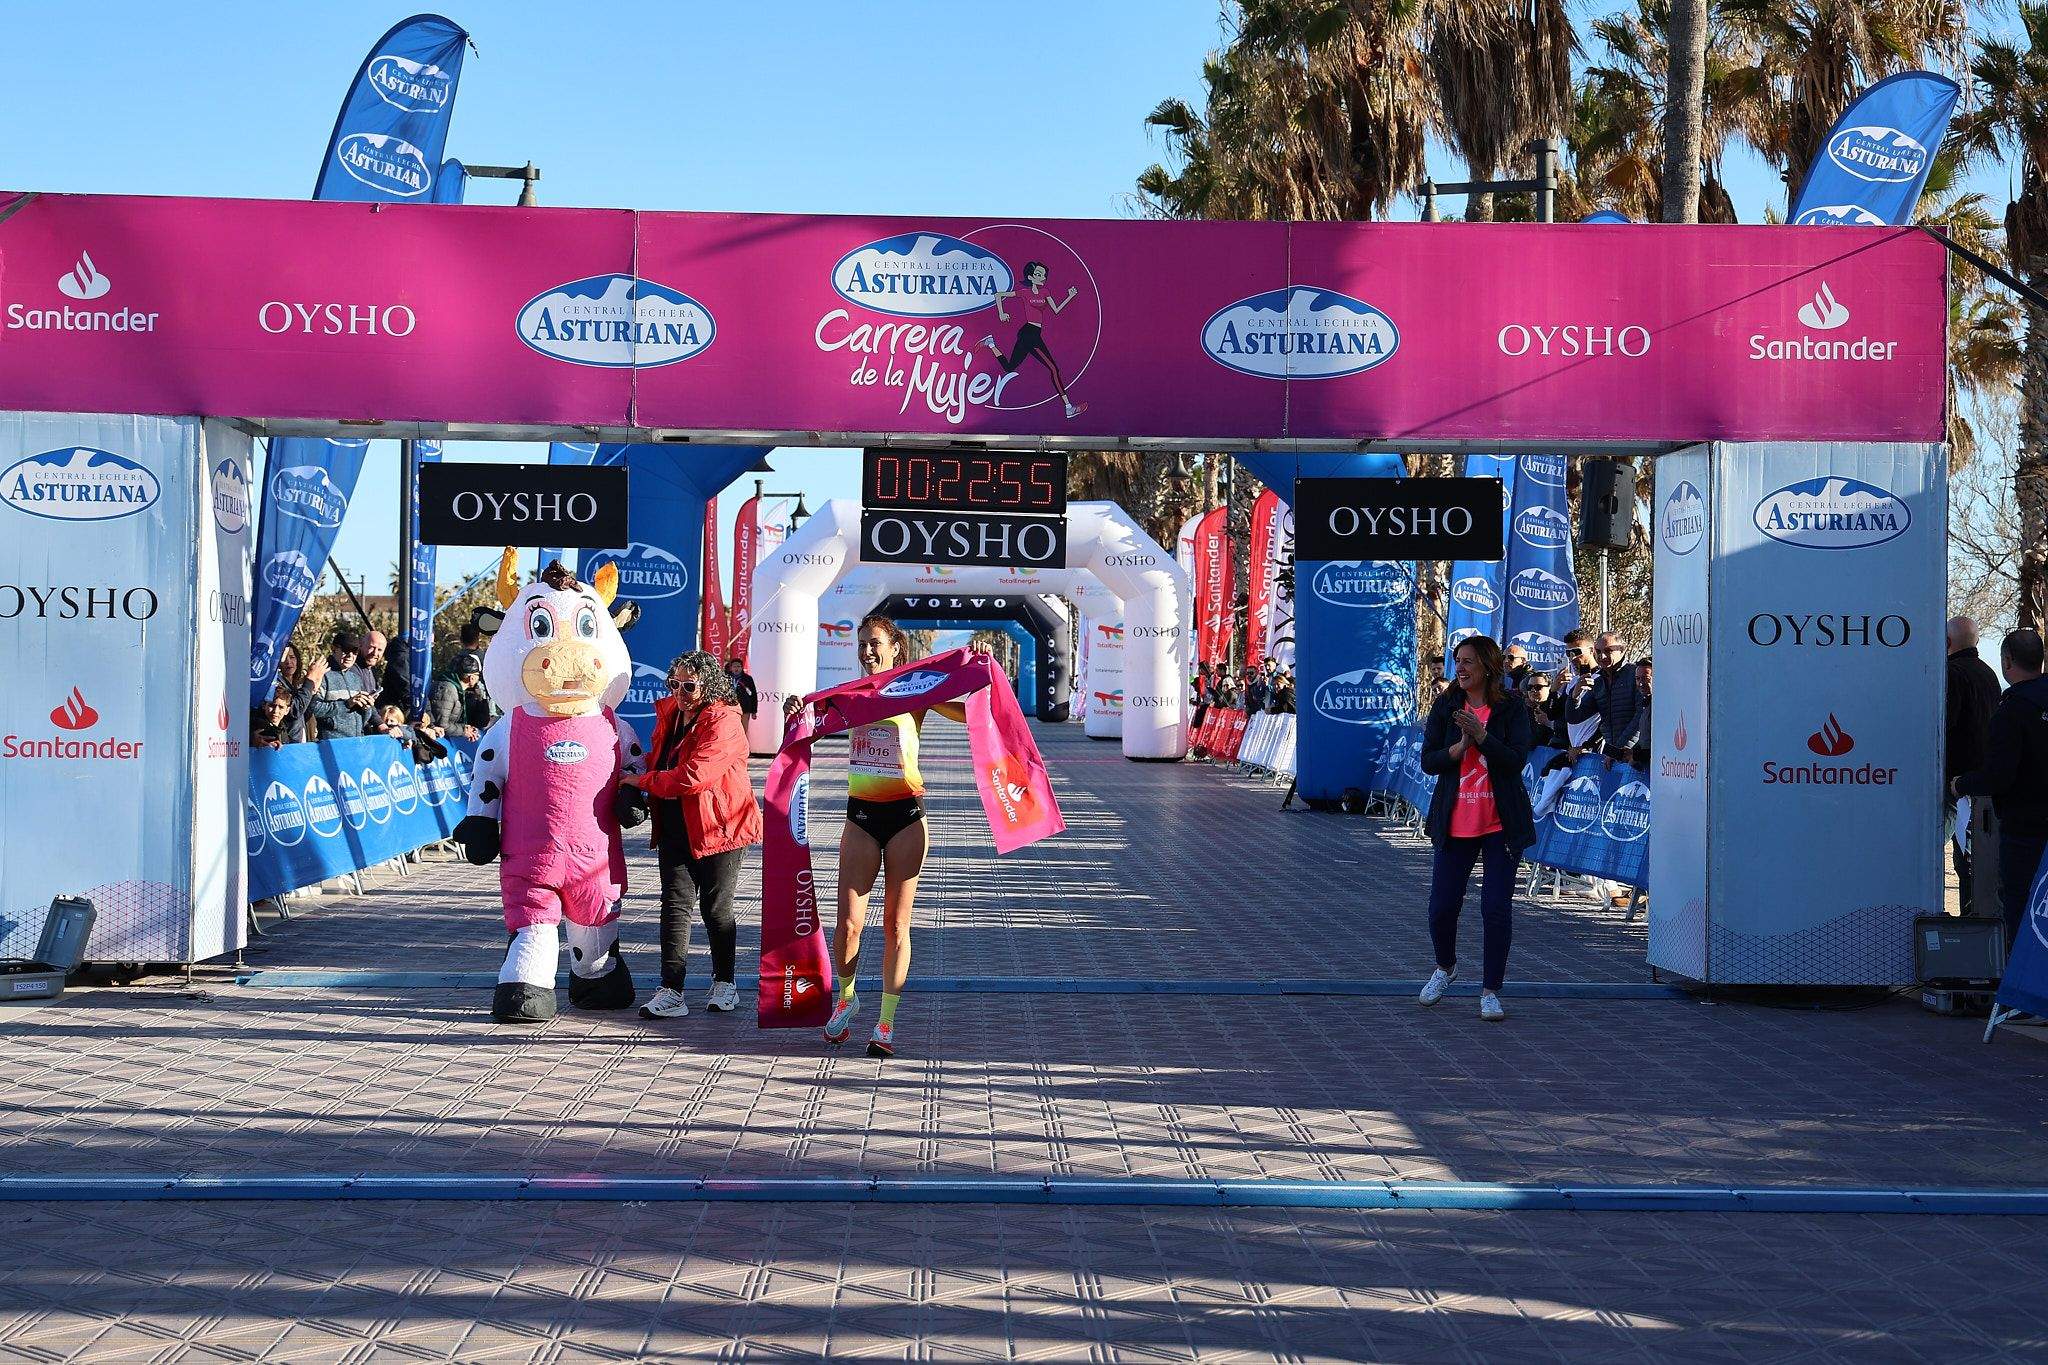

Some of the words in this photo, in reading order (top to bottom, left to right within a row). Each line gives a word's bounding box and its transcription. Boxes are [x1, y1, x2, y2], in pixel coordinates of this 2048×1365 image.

[845, 261, 999, 296] ASTURIANA
[874, 260, 931, 270] CENTRAL
[936, 261, 995, 271] LECHERA
[7, 303, 159, 333] Santander
[258, 301, 417, 338] OYSHO
[563, 305, 626, 315] CENTRAL
[1247, 318, 1310, 327] CENTRAL
[1314, 318, 1378, 328] LECHERA
[531, 306, 701, 345] ASTURIANA
[815, 308, 964, 356] Carrera
[1216, 320, 1384, 355] ASTURIANA
[1497, 323, 1652, 357] OYSHO
[1748, 334, 1898, 362] Santander
[850, 355, 879, 386] de
[883, 355, 905, 387] la
[898, 351, 1020, 424] Mujer
[8, 472, 149, 503] ASTURIANA
[35, 471, 87, 480] CENTRAL
[91, 473, 144, 481] LECHERA
[877, 457, 1052, 504] 00:22:55
[452, 491, 598, 523] OYSHO
[1764, 502, 1899, 531] ASTURIANA
[1789, 501, 1839, 509] CENTRAL
[1843, 502, 1894, 510] LECHERA
[1328, 506, 1473, 536] OYSHO
[1519, 516, 1568, 541] ASTURIAN
[871, 517, 1057, 561] OYSHO
[1258, 505, 1278, 600] Santander
[737, 522, 751, 606] Santander
[782, 553, 834, 566] OYSHO
[1104, 555, 1156, 567] OYSHO
[1207, 532, 1221, 612] Santander
[999, 577, 1041, 585] TotalEnergies
[1515, 579, 1569, 603] ASTURIANA
[0, 584, 158, 621] OYSHO
[210, 589, 246, 627] OYSHO
[904, 598, 1007, 608] VOLVO
[757, 621, 806, 634] OYSHO
[1132, 625, 1181, 638] OYSHO
[1660, 612, 1703, 647] OYSHO
[1747, 613, 1912, 648] OYSHO
[1047, 637, 1057, 712] VOLVO
[1132, 696, 1180, 708] OYSHO
[3, 735, 144, 760] Santander
[868, 746, 890, 757] 016
[1661, 755, 1698, 779] Santander
[1762, 761, 1899, 785] Santander
[991, 767, 1018, 824] Santander
[266, 807, 304, 833] ASTURIANA
[1602, 800, 1650, 829] ASTURIANA
[794, 869, 814, 937] OYSHO
[783, 964, 796, 1009] Santander
